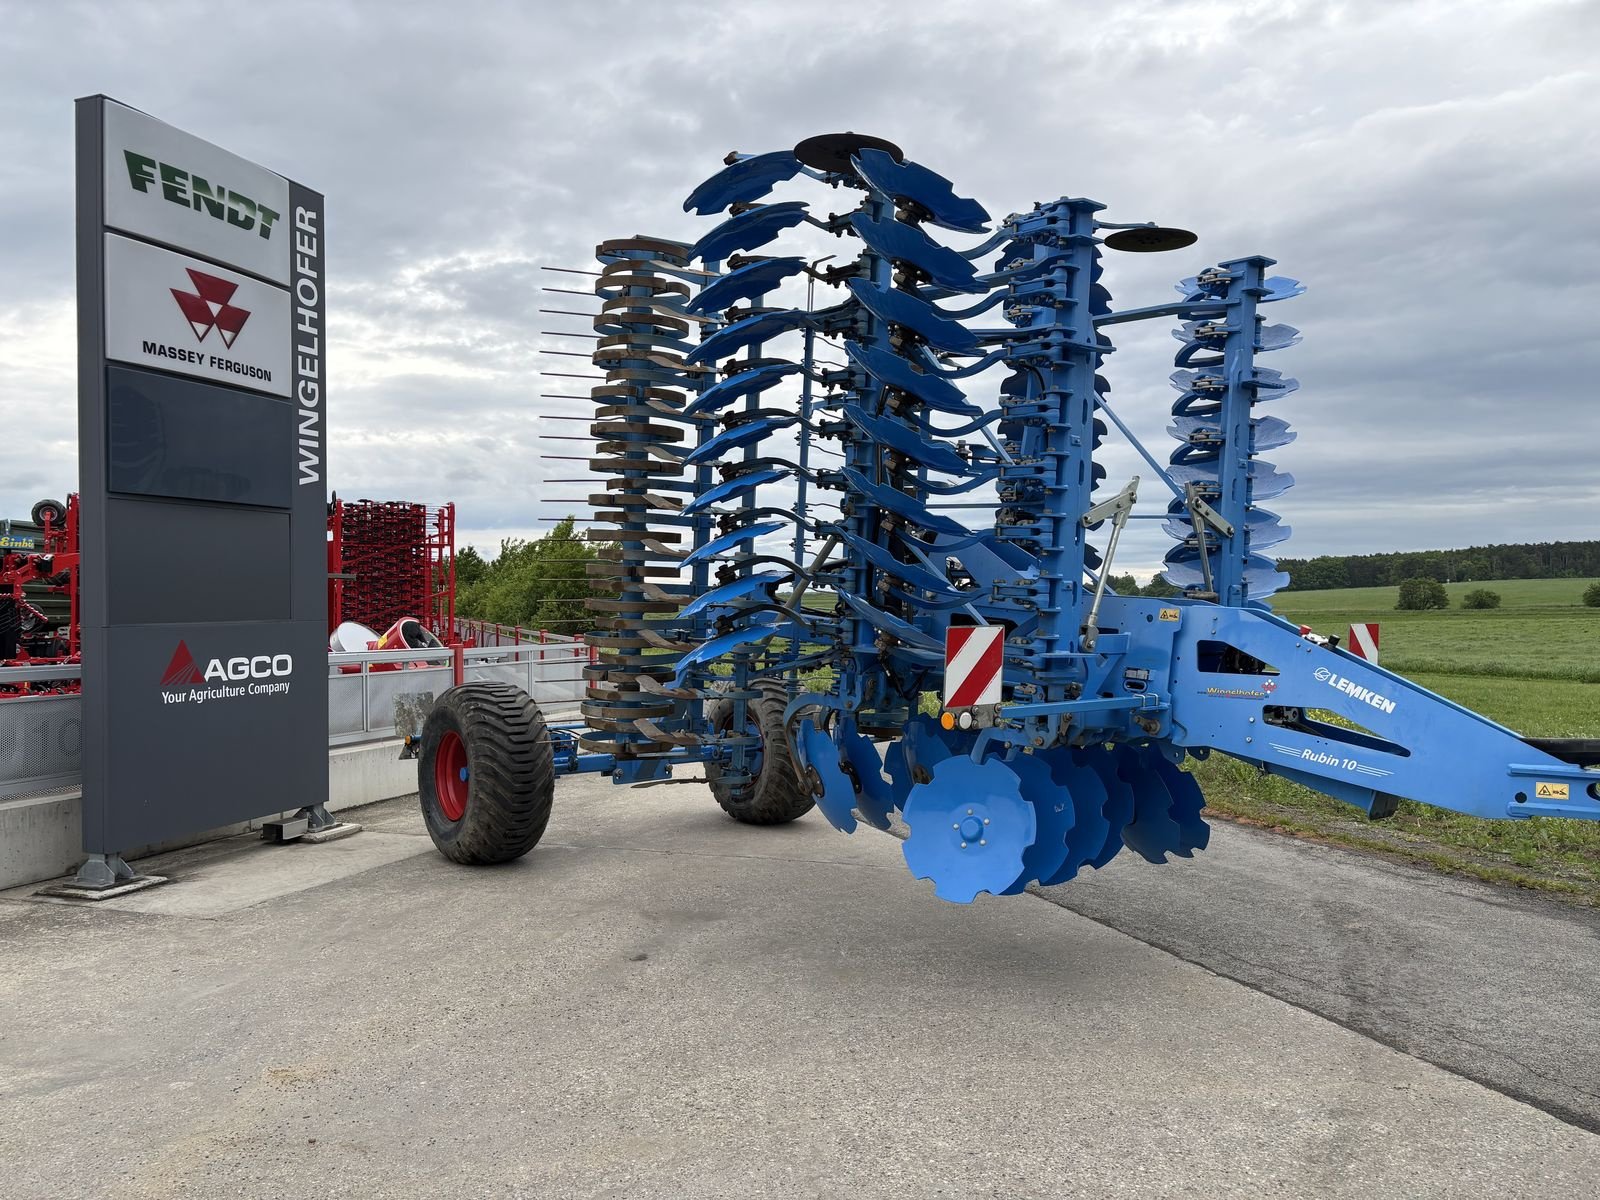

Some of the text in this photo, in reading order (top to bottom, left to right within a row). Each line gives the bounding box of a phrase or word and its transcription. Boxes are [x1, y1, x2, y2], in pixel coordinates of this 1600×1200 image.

[123, 149, 281, 240] FENDT
[142, 340, 272, 382] MASSEY FERGUSON
[295, 205, 320, 486] WINGELHOFER
[204, 653, 293, 682] AGCO
[161, 682, 290, 705] Your Agriculture Company
[1328, 675, 1396, 714] LEMKEN
[1301, 748, 1357, 772] Rubin 10
